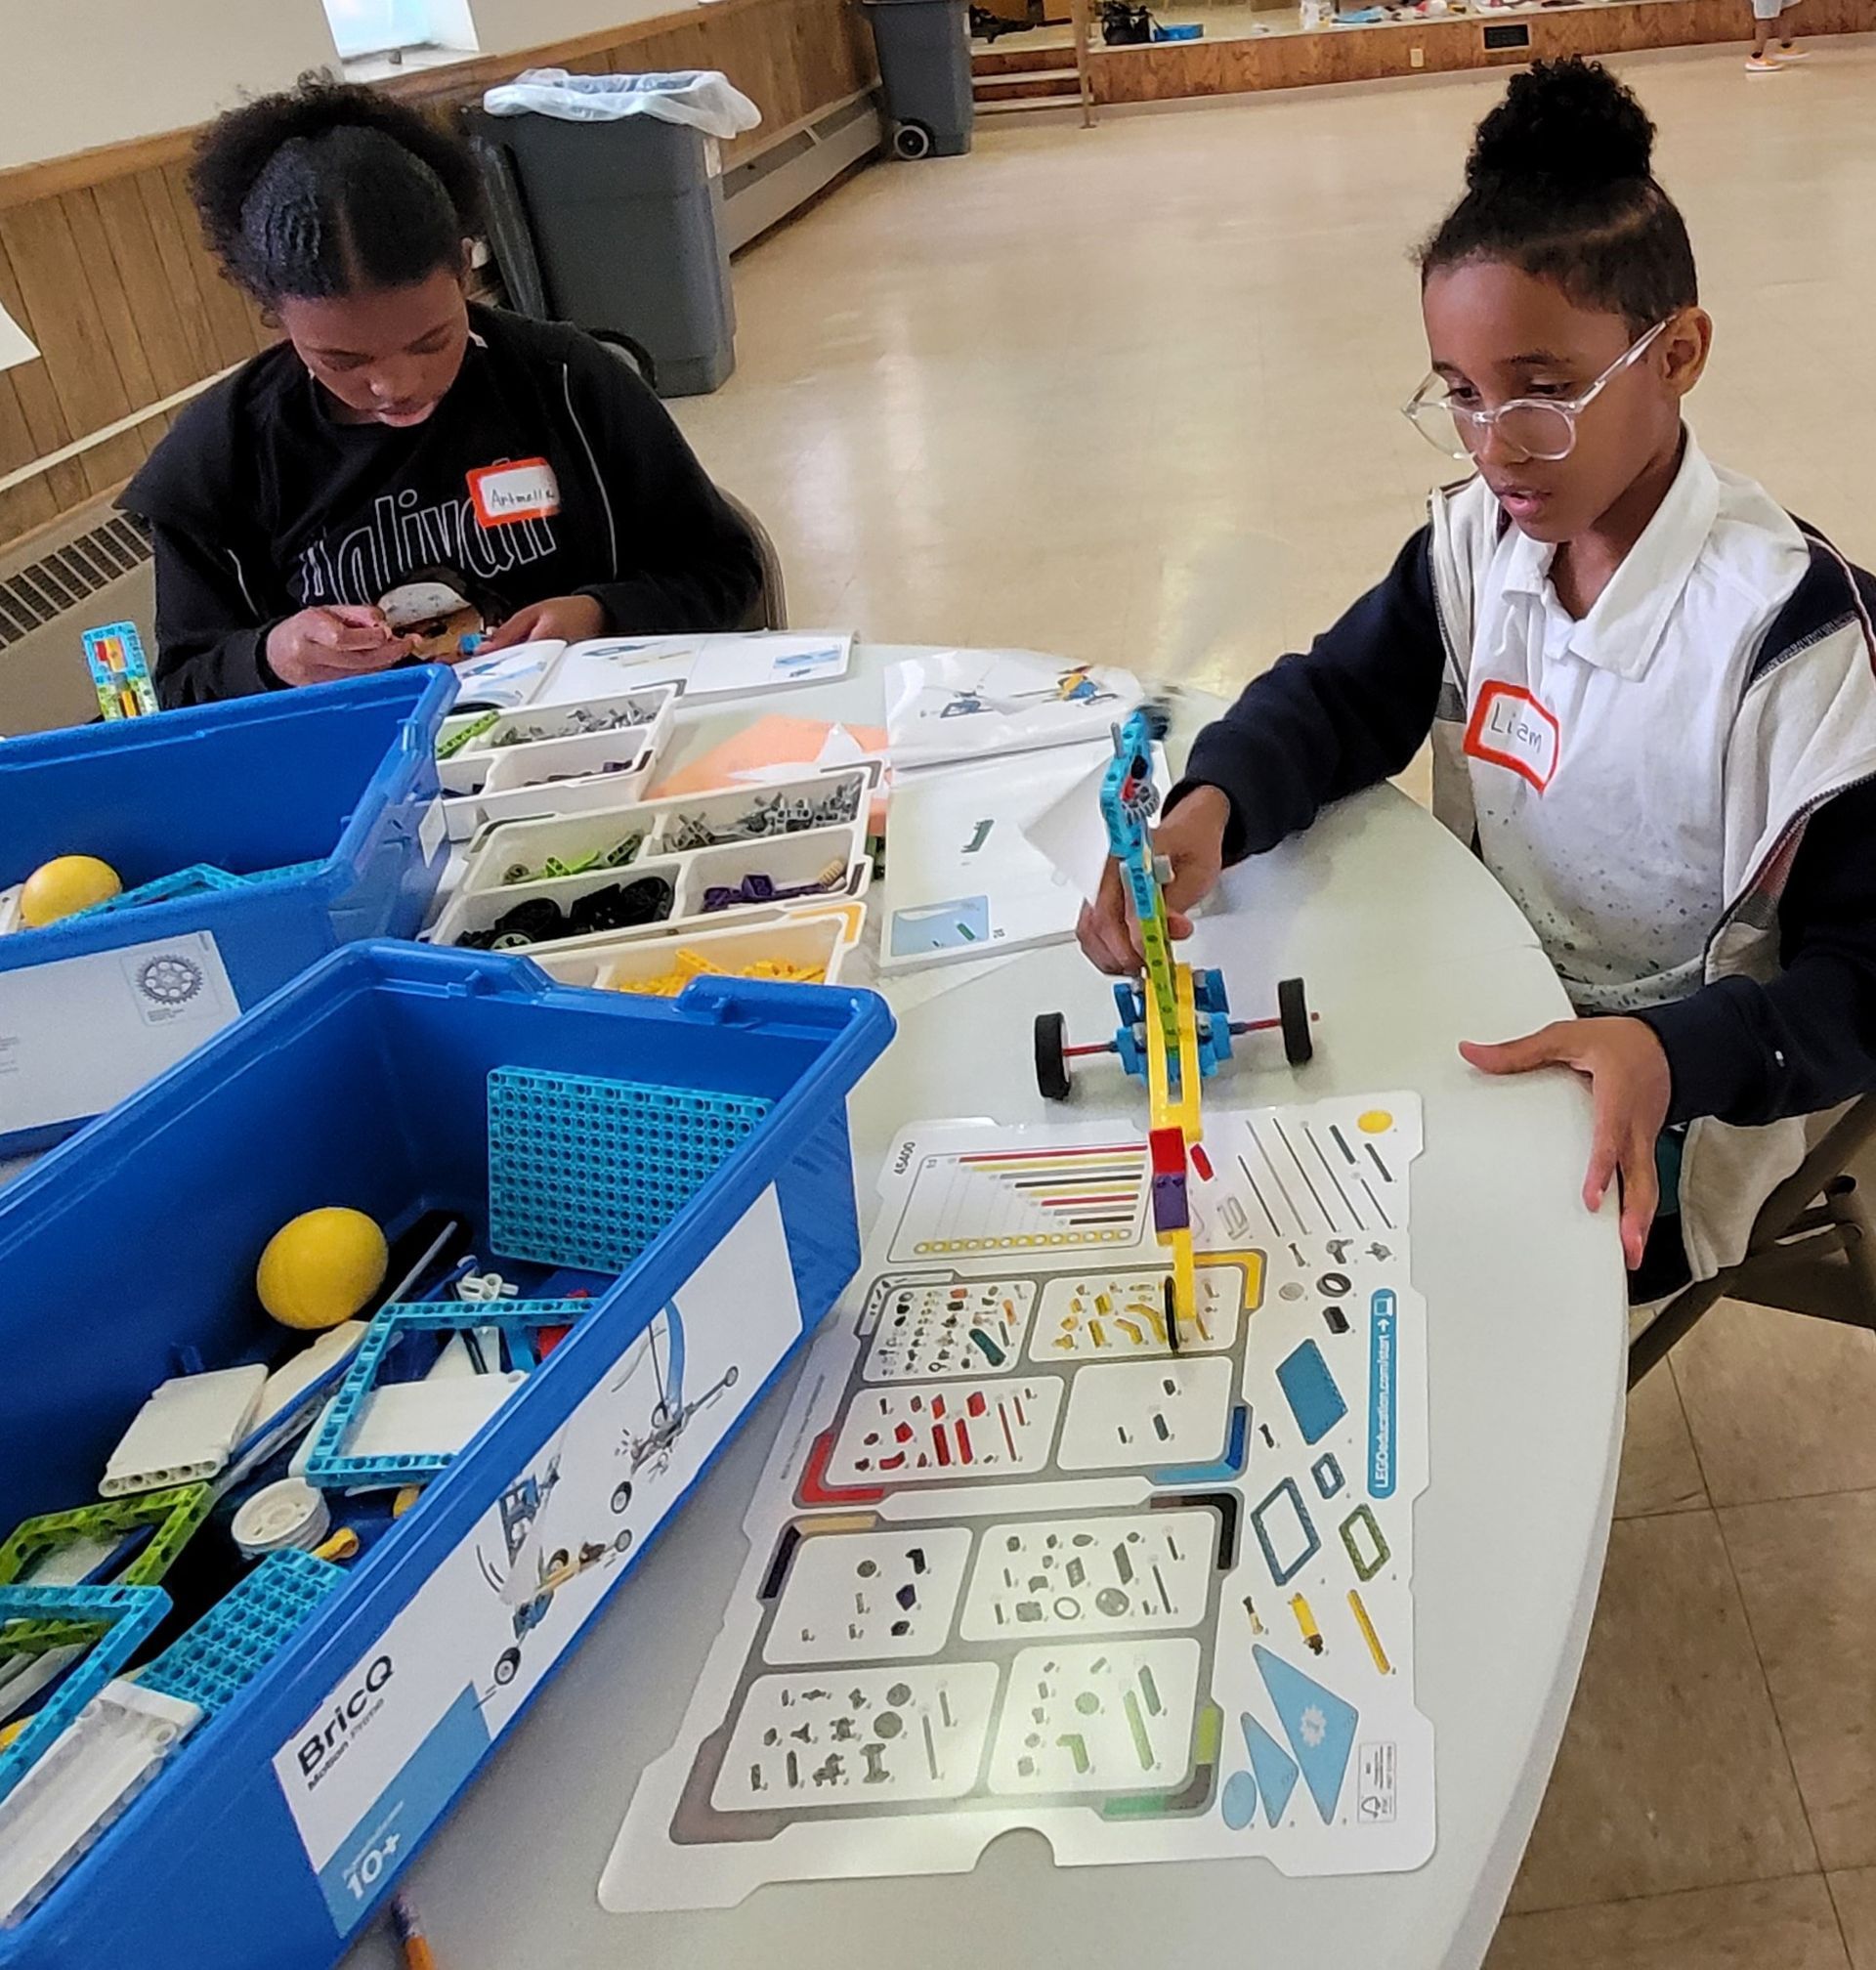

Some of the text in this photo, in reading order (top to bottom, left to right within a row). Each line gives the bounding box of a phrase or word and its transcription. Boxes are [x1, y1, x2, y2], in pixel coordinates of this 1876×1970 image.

[1490, 702, 1542, 754] Liam
[893, 1141, 916, 1175] 45400
[1374, 1334, 1389, 1488] LEGOeducation.com/start
[297, 1654, 395, 1777] BricQ
[308, 1697, 385, 1791] Motion Prime
[347, 1833, 401, 1901] 10+
